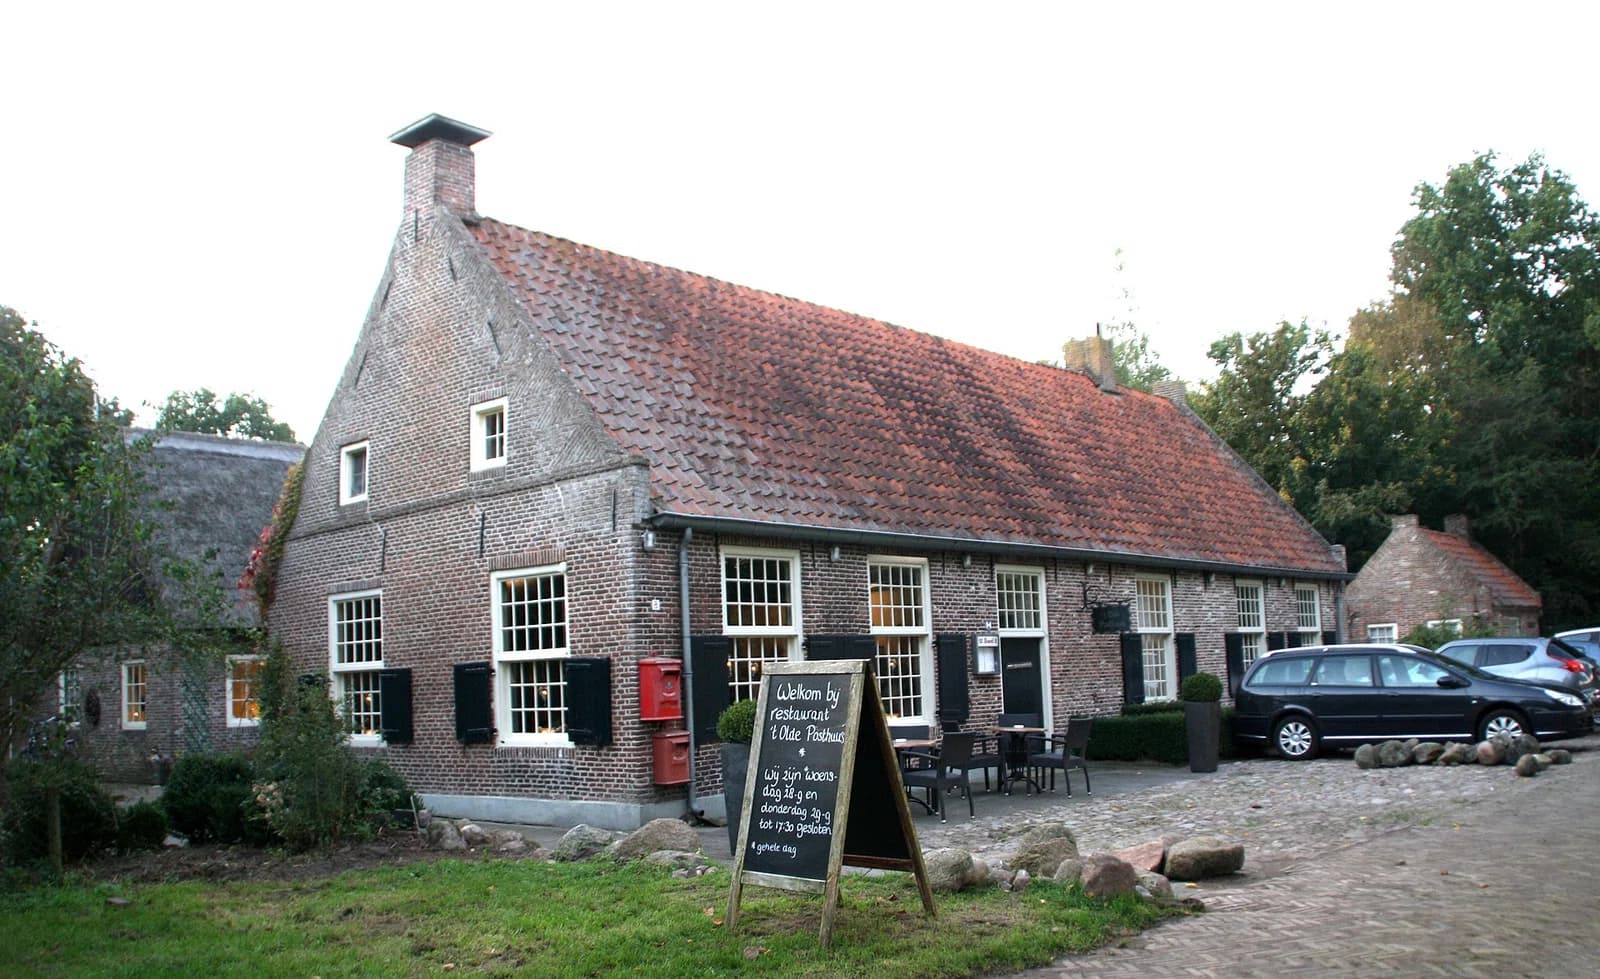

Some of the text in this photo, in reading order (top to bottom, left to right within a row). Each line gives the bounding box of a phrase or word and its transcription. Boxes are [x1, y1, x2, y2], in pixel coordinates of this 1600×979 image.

[777, 682, 822, 701] Welkom
[770, 705, 830, 721] restaurant
[779, 724, 802, 741] Olde
[762, 785, 782, 803] dag
[805, 791, 818, 801] en
[760, 801, 808, 821] donderdag
[759, 818, 774, 830] tot
[796, 821, 832, 838] gesloten
[756, 842, 797, 858] gehele dag
